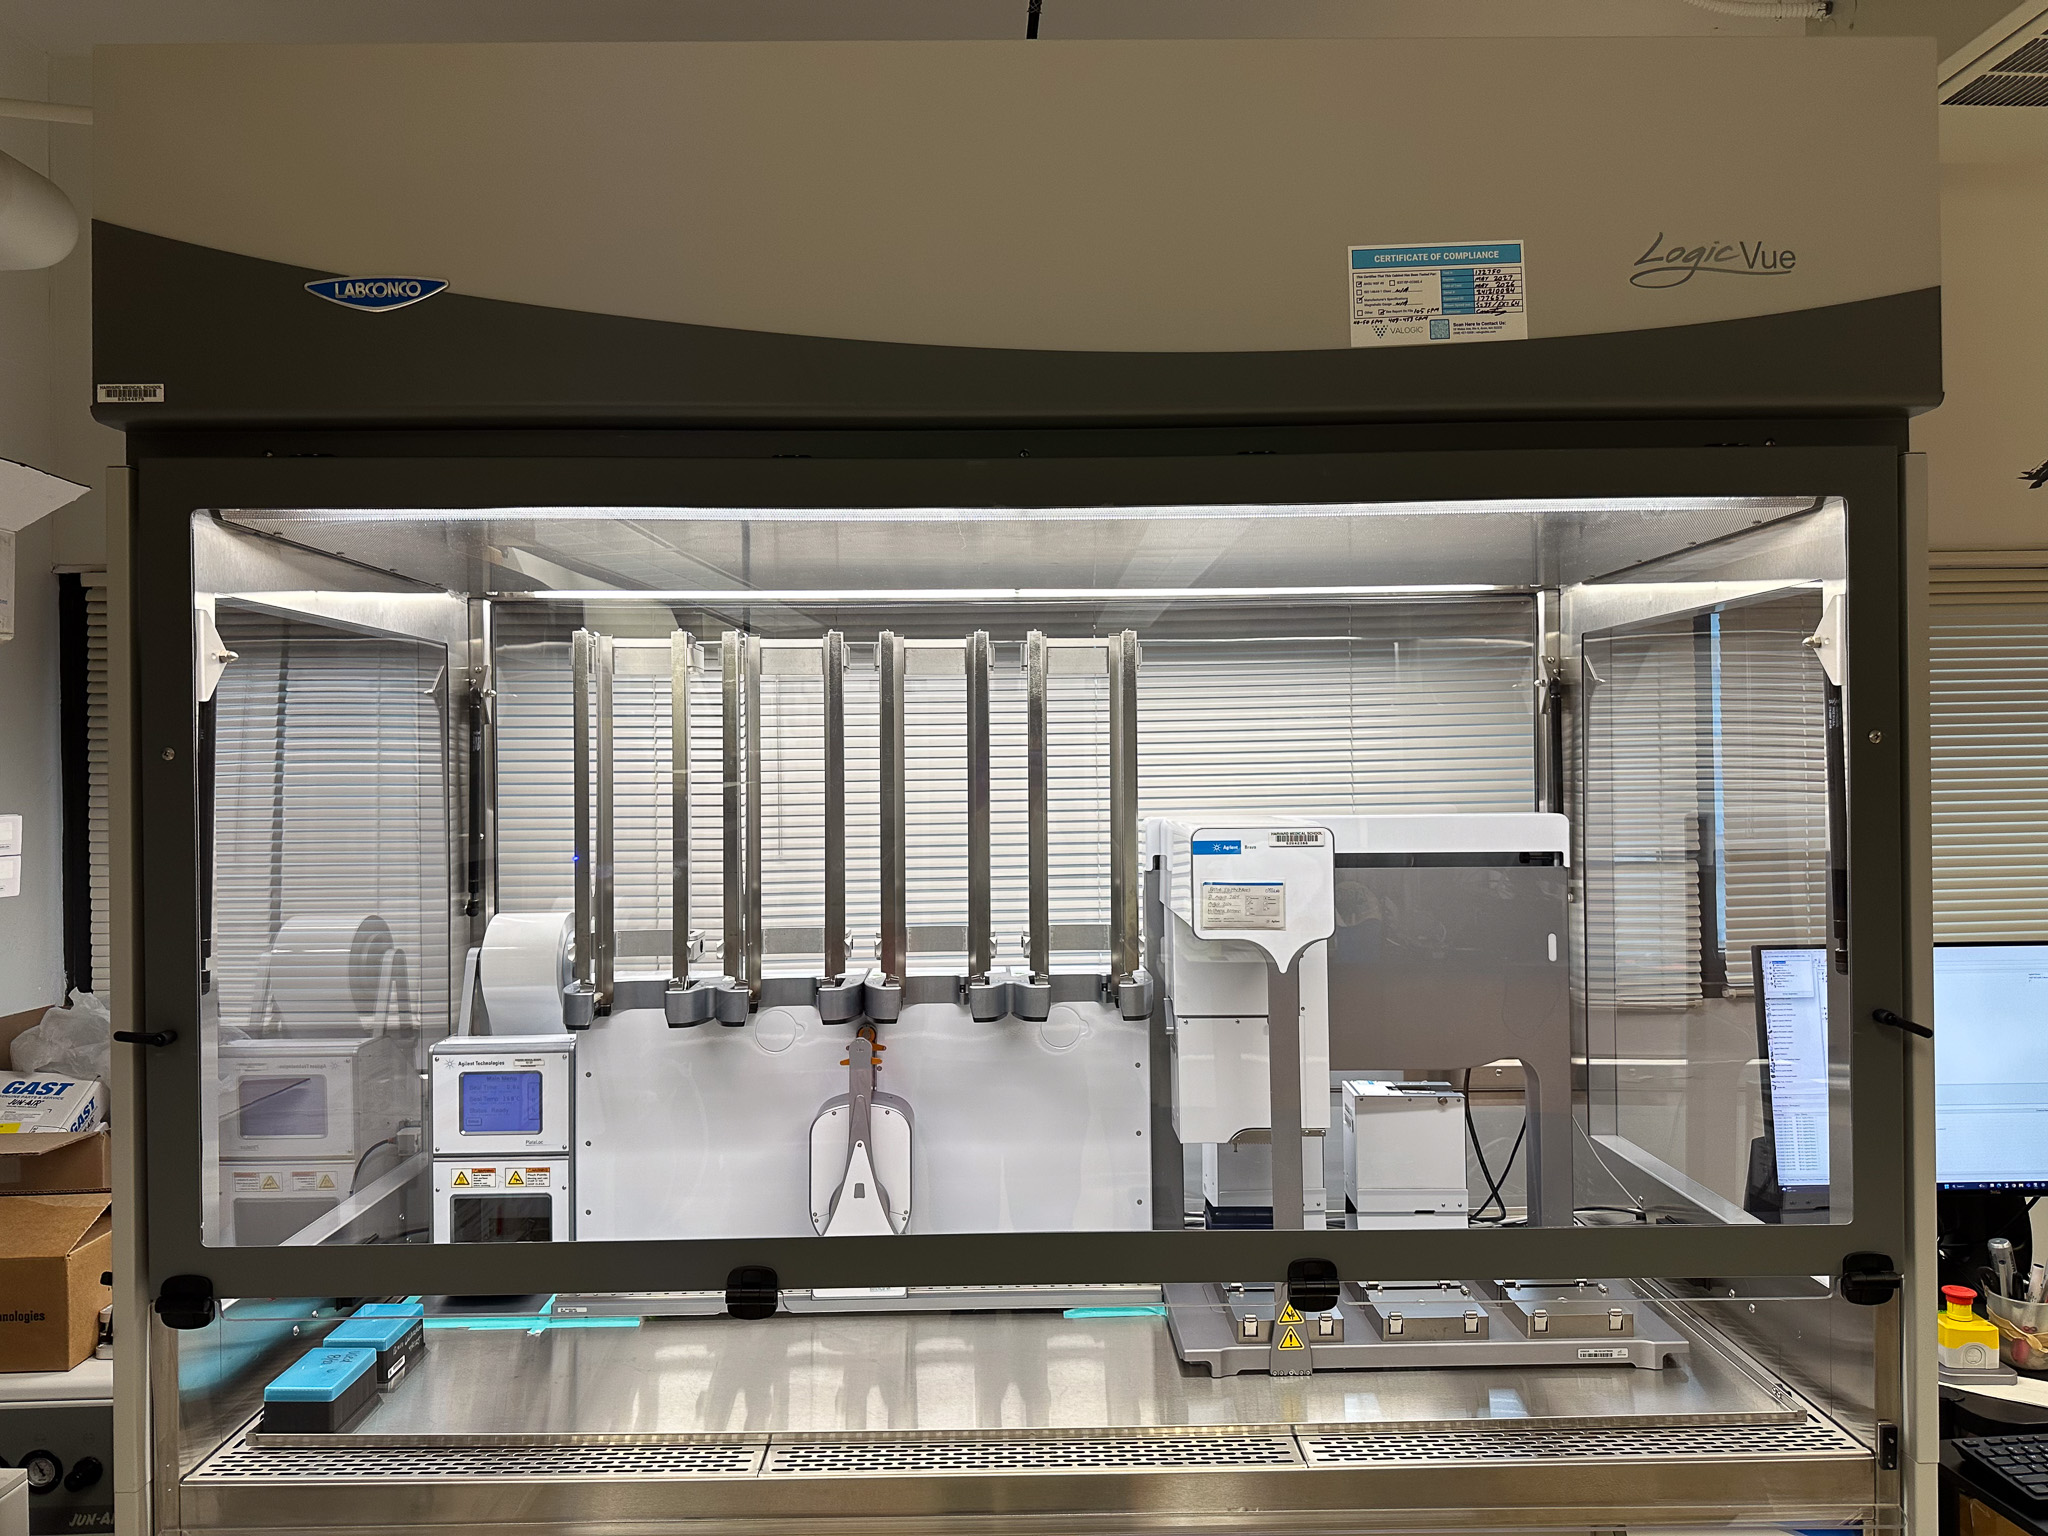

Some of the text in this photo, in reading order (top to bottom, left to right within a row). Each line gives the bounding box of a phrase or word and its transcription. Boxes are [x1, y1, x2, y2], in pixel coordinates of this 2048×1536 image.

[1374, 250, 1500, 263] CERTIFICATE OF COMPLIANCE
[334, 281, 422, 299] LABCONCO
[1390, 326, 1424, 334] VALOGIC
[1, 1080, 75, 1096] GAST
[70, 1096, 95, 1132] GAST
